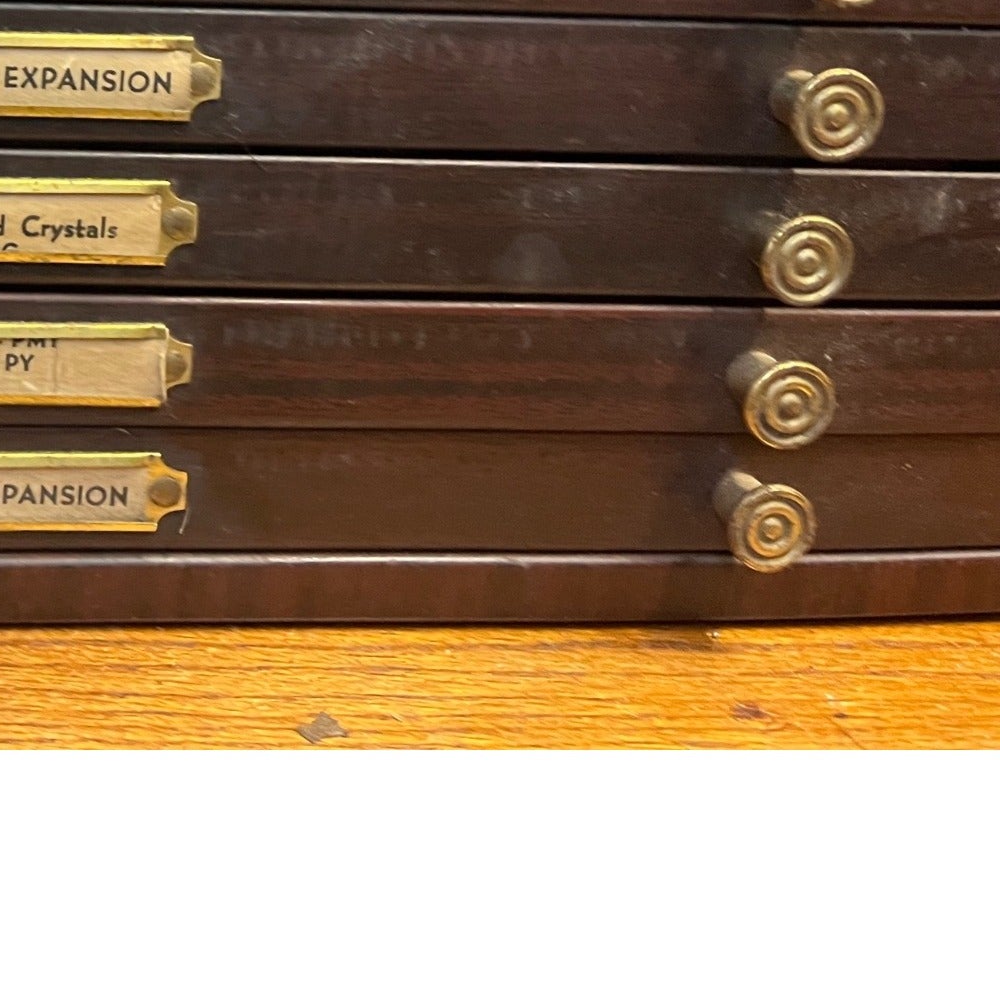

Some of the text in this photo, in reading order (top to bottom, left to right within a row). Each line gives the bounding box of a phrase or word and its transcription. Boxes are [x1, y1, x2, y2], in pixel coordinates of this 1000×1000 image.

[3, 65, 172, 95] EXPANSION
[21, 214, 118, 243] Crystals
[4, 353, 35, 372] PY
